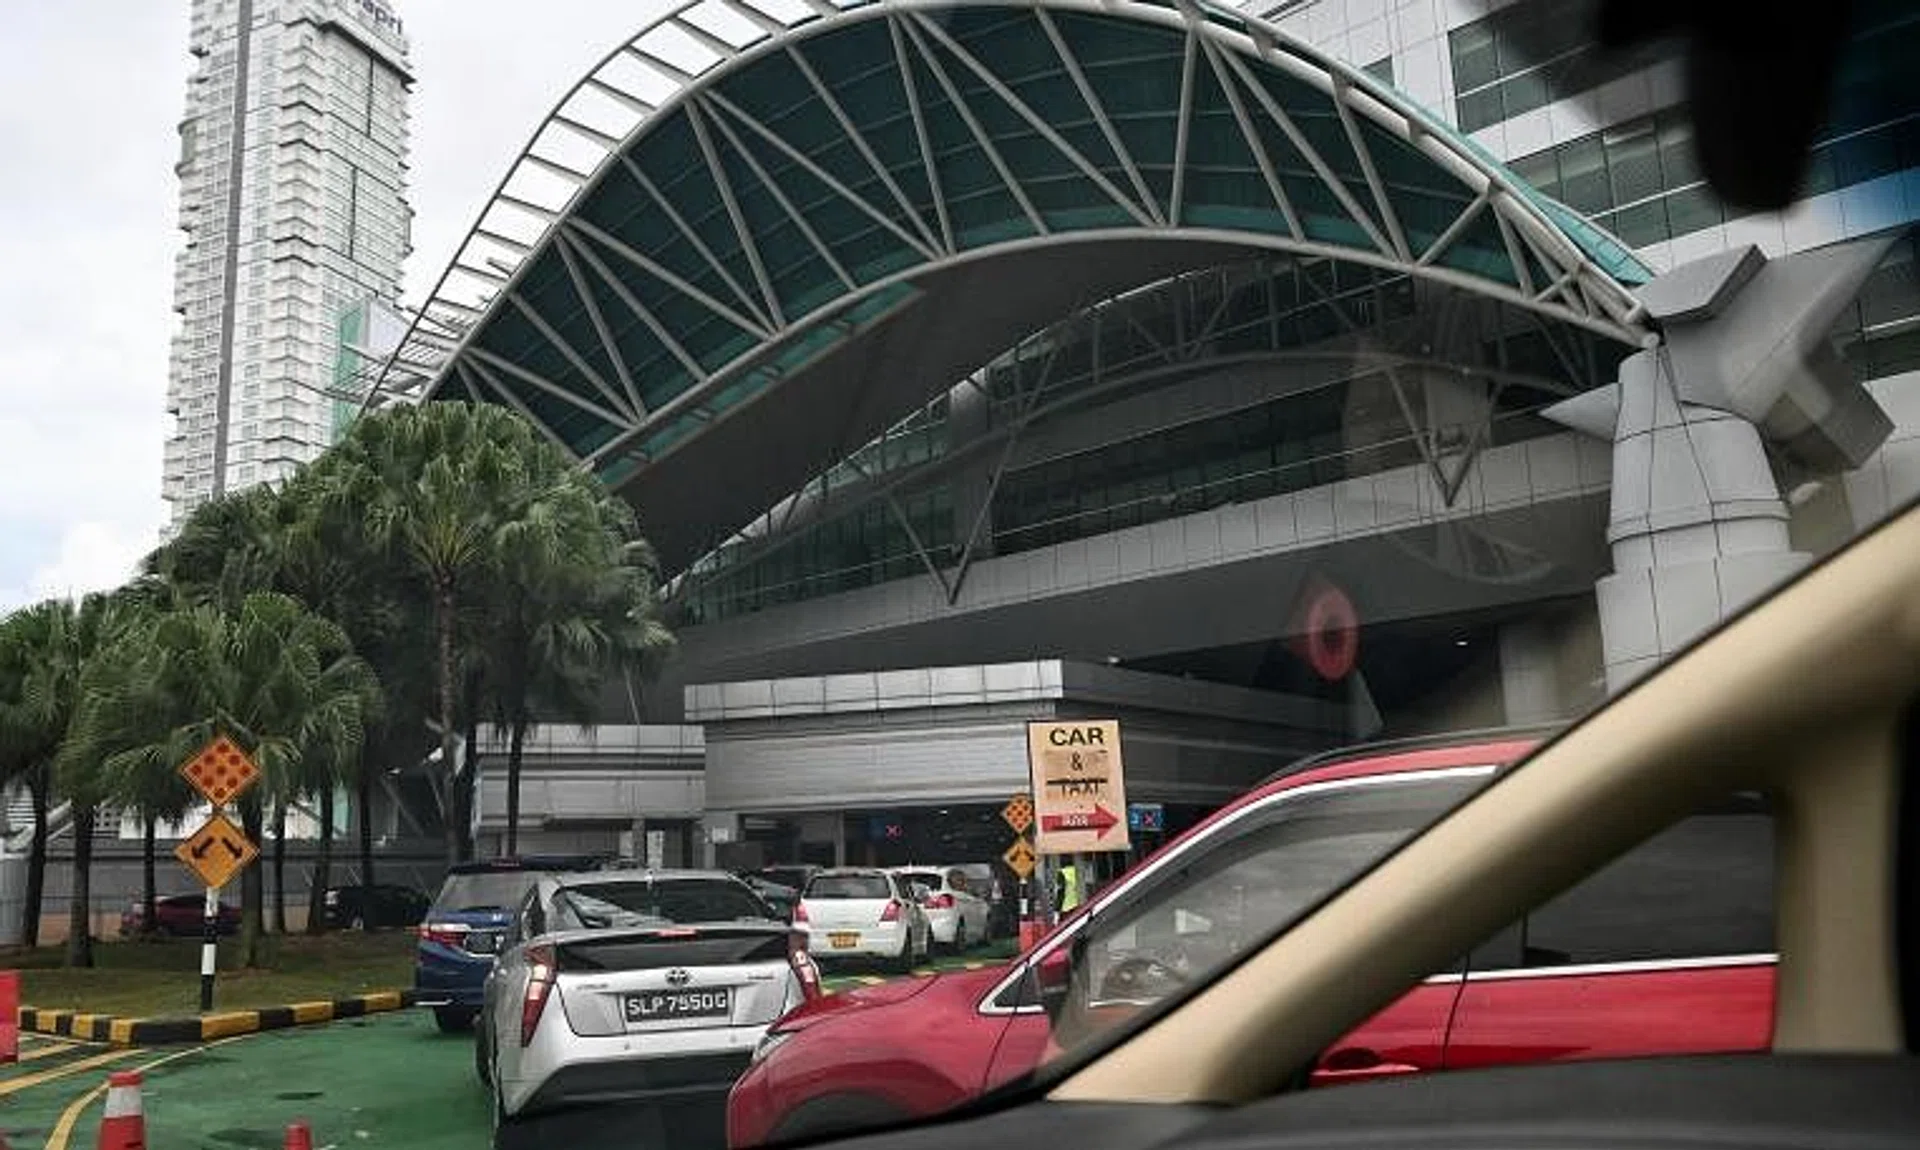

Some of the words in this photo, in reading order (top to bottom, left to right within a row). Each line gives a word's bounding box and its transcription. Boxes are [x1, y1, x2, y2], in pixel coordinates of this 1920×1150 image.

[354, 0, 403, 35] apri
[1049, 727, 1104, 746] CAR
[1071, 751, 1083, 771] &
